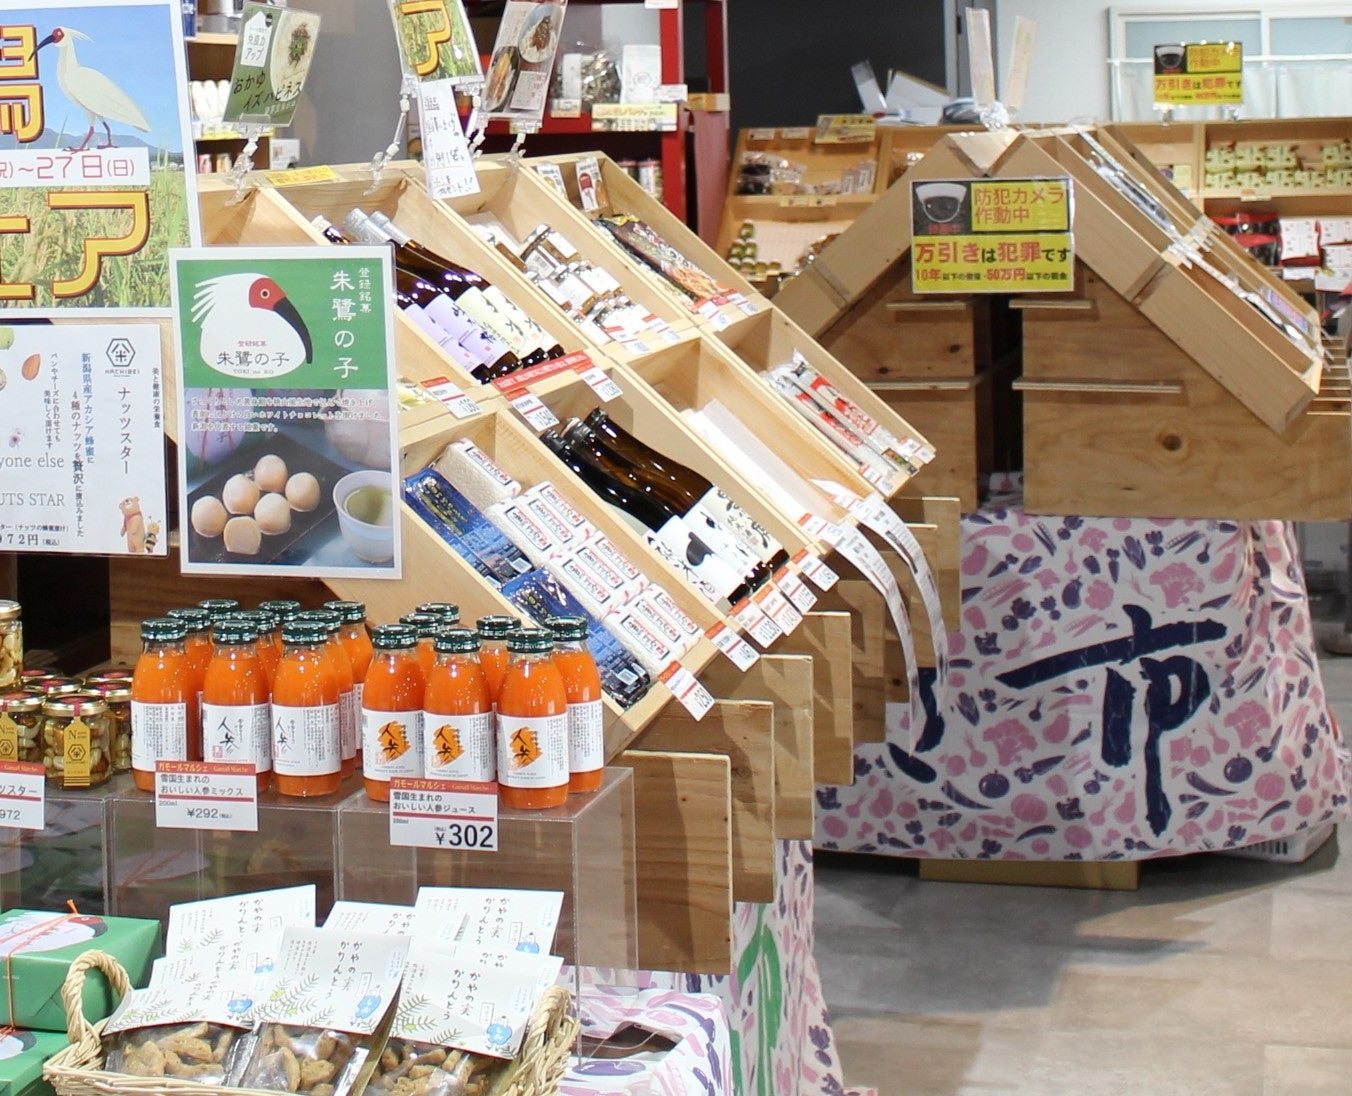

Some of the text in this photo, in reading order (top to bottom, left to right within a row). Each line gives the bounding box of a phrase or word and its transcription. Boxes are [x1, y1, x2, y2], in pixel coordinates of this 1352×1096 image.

[974, 186, 1065, 205] 防犯カメラ
[974, 206, 1029, 225] 作動中
[914, 242, 1071, 264] 万引きは犯罪です
[329, 269, 359, 380] 朱鷺の子
[216, 351, 290, 367] 朱鷺の子
[81, 352, 96, 465] 新潟県産アカシア蜂蜜に
[118, 386, 133, 475] ナッツスター
[36, 454, 66, 469] else
[28, 492, 66, 507] STAR
[158, 763, 208, 773] ガモールマルシェ
[160, 773, 210, 784] 雪国生まれの
[393, 779, 447, 791] ガモールマルシェ
[160, 786, 243, 797] おいしい人参ミックス
[393, 791, 443, 803] 雪国生まれの
[187, 808, 219, 819] ¥292
[393, 802, 476, 814] おいしい人参ジュース
[435, 823, 494, 848] ¥302
[324, 939, 350, 1000] かりんとう
[342, 940, 363, 992] かやの実
[442, 969, 465, 1022] かりんとう
[460, 972, 482, 1016] かやの実
